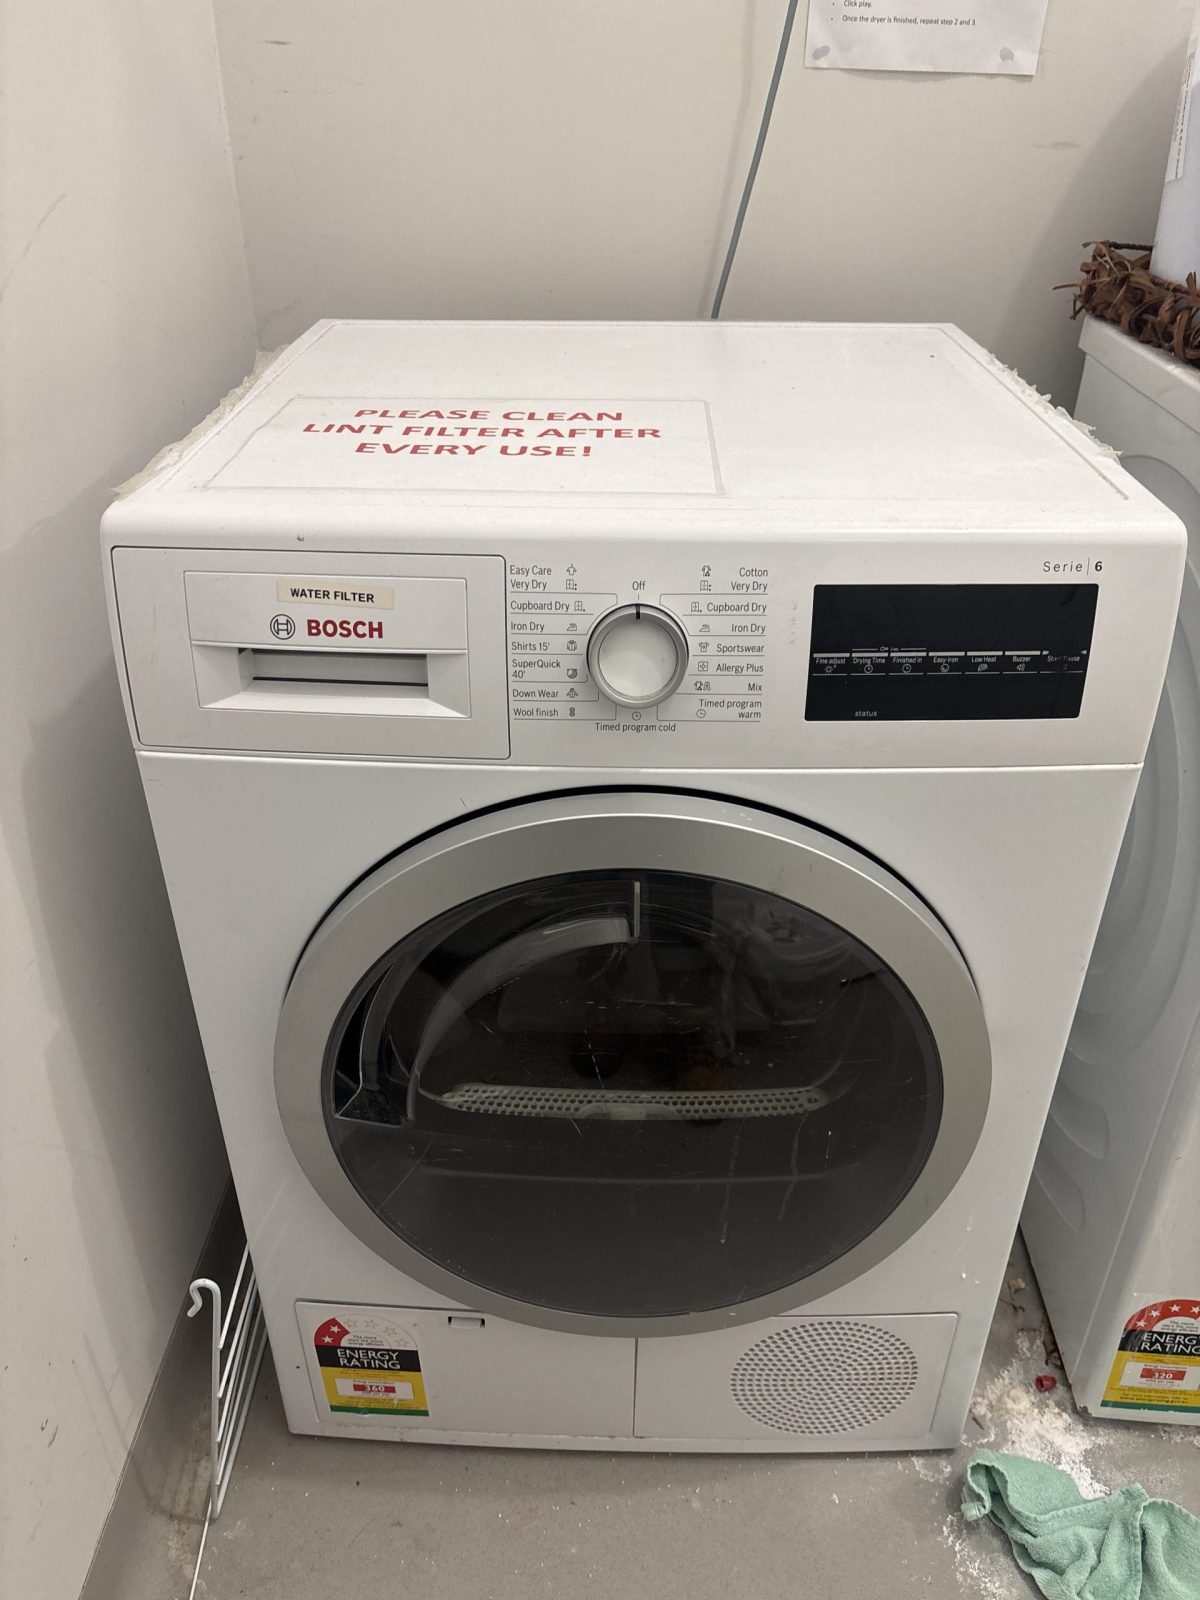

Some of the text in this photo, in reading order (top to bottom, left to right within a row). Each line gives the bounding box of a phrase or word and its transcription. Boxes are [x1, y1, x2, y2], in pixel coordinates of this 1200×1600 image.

[870, 16, 886, 24] dryer
[893, 17, 919, 25] finished,
[354, 409, 623, 421] PLEASE CLEAN
[302, 423, 662, 439] LINT FILTER AFTER
[355, 442, 593, 457] EVERY USE!
[510, 565, 552, 577] Easy Care
[739, 567, 768, 577] Cotton
[1042, 561, 1103, 573] Serie 6
[510, 580, 547, 592] Very Dry
[632, 581, 645, 590] Off
[731, 581, 768, 593] Very Dry
[290, 588, 374, 603] WATER FILTER
[510, 601, 570, 613] Cupboard Dry
[707, 602, 767, 614] Cupboard Dry
[307, 619, 383, 638] BOSCH
[511, 622, 545, 633] Iron Dry
[731, 623, 766, 634] Iron Dry
[511, 641, 550, 651] Shirts 15'
[716, 643, 765, 655] Sportswear
[512, 659, 561, 671] SuperQuick
[716, 663, 764, 675] Allergy Plus
[512, 670, 526, 679] 40'
[748, 682, 762, 692] Mix
[512, 689, 559, 699] Down Wear
[700, 699, 762, 711] Timed program
[514, 708, 559, 717] Wool finish
[738, 711, 761, 719] warm
[596, 723, 676, 734] Timed program cold
[1143, 1333, 1200, 1344] ENERG
[337, 1349, 399, 1360] ENERGY
[340, 1358, 401, 1369] RATING
